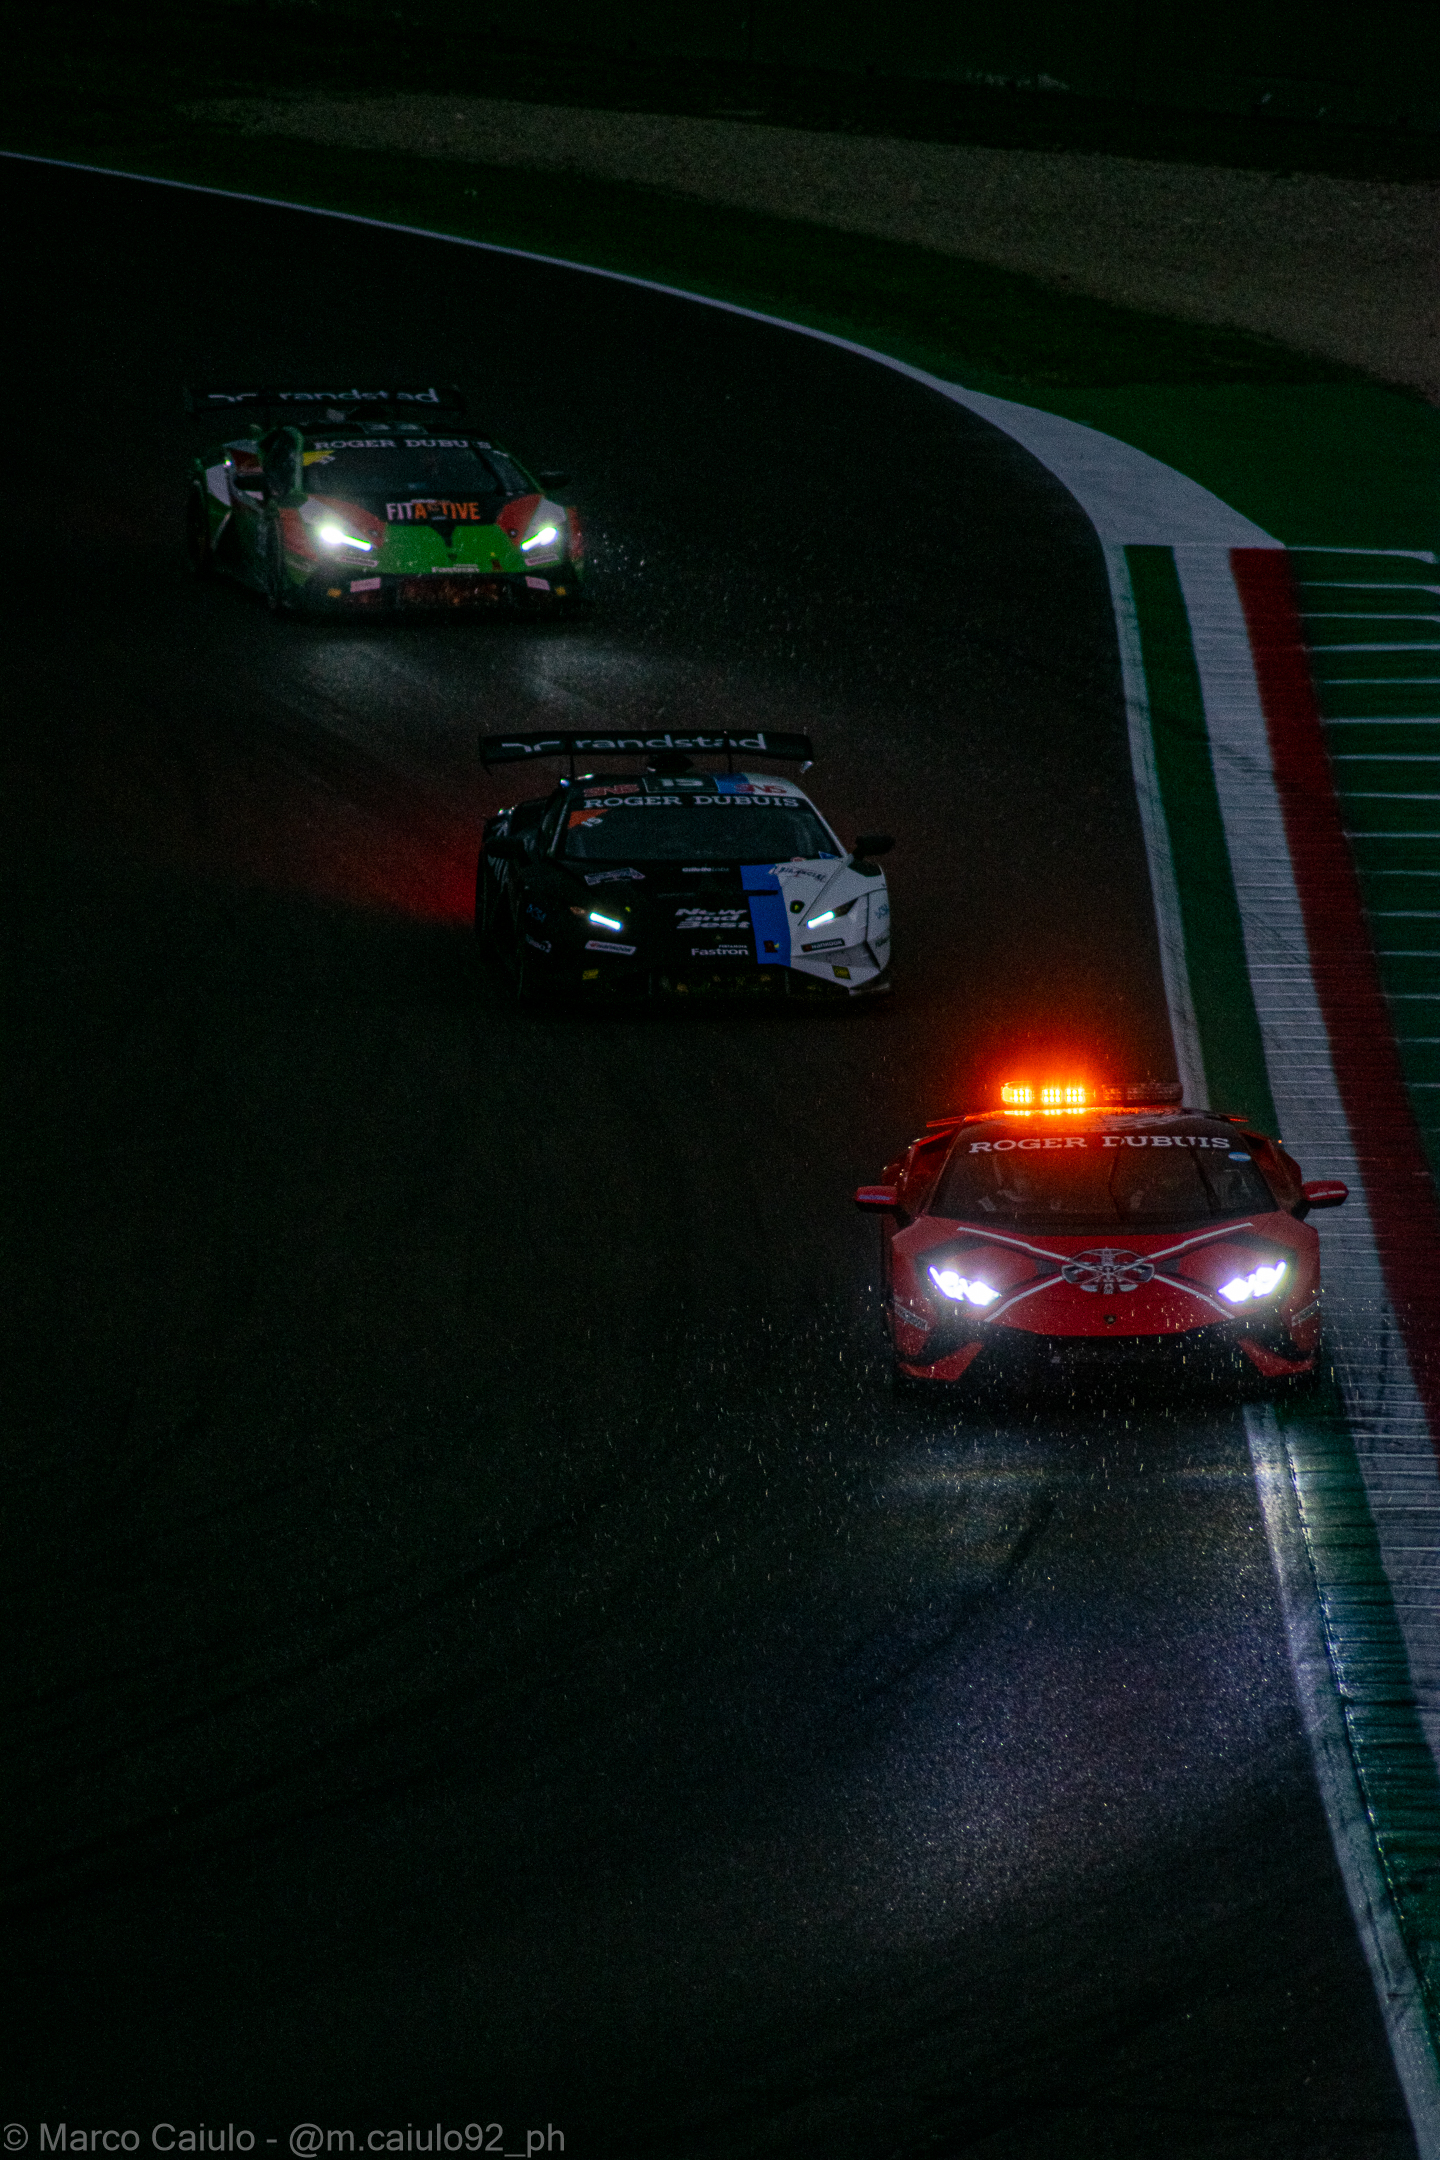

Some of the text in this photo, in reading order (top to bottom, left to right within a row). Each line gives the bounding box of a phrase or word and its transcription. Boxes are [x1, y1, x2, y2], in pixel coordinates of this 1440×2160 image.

[314, 439, 492, 450] ROGER DUBUS
[386, 502, 481, 520] FITATIVE
[575, 733, 768, 750] randstad
[583, 795, 800, 809] ROGER DUBUIS
[690, 947, 750, 957] Fastron
[968, 1135, 1231, 1154] ROGER DUBUIS
